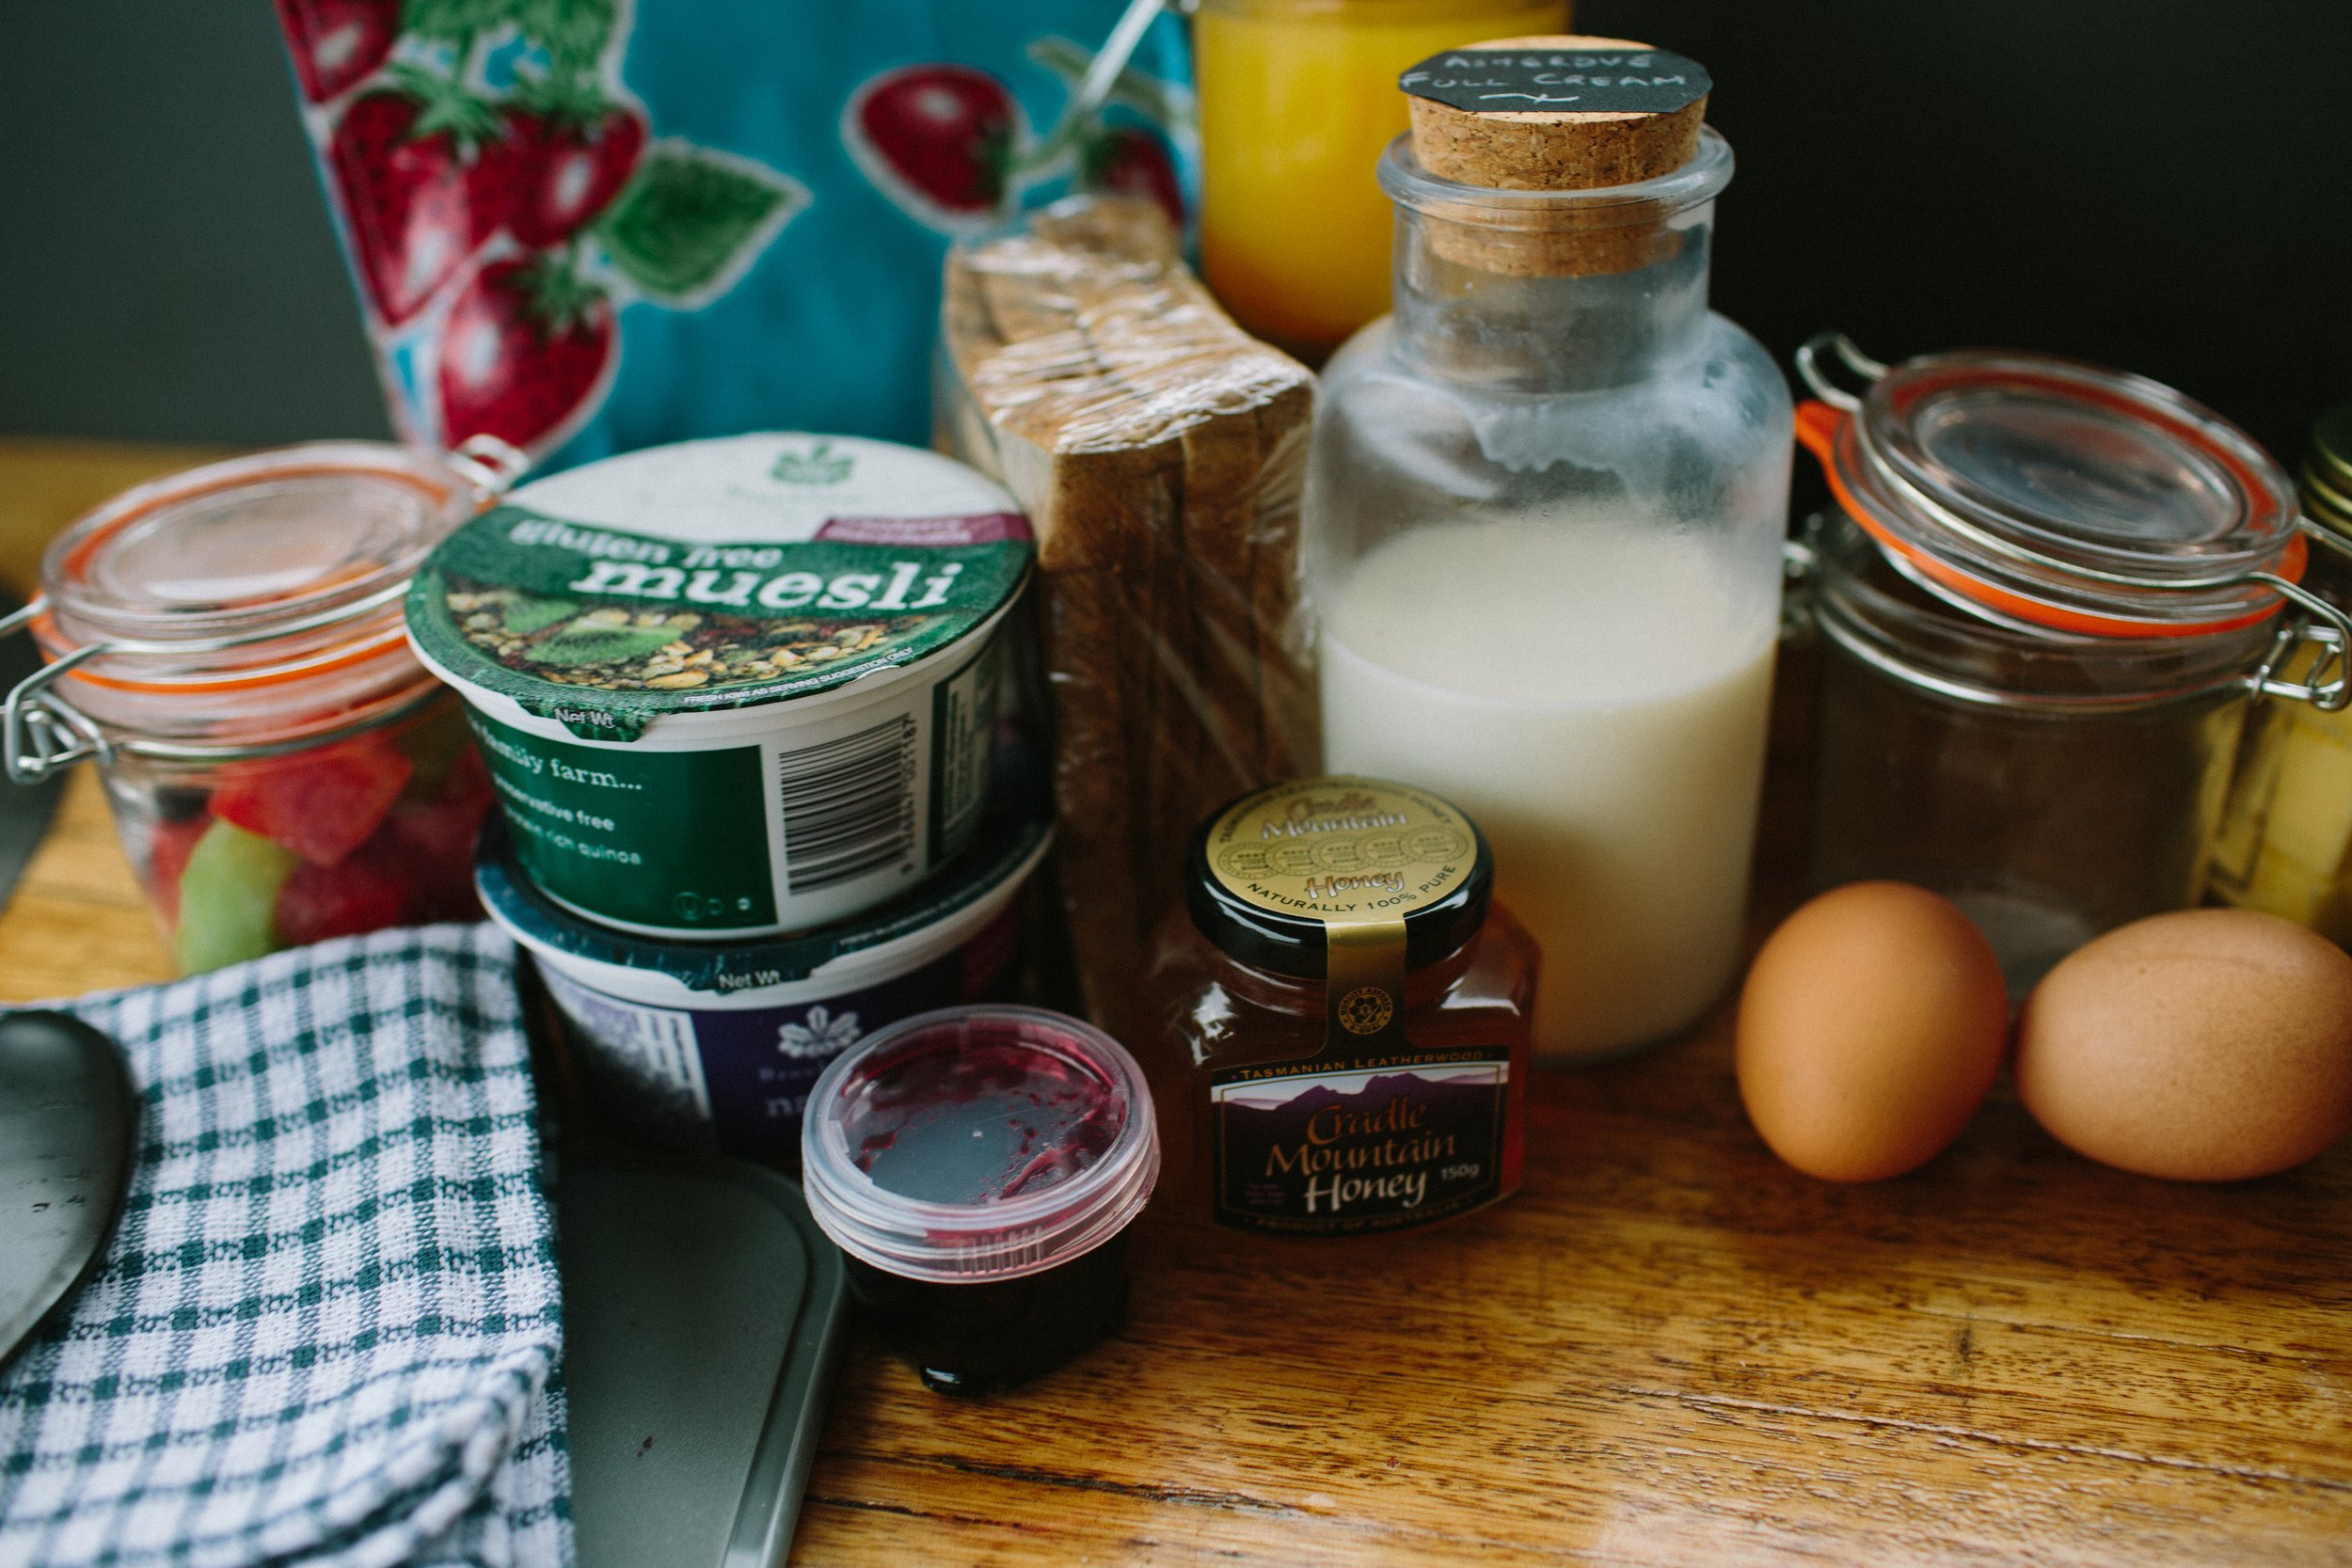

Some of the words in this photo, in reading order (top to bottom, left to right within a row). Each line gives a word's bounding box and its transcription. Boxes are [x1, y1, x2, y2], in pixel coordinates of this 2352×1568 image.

[1400, 71, 1511, 88] FULL
[1532, 72, 1687, 87] CREAM
[682, 545, 784, 568] free
[568, 561, 963, 610] muesli
[684, 692, 723, 705] FRESH
[769, 676, 819, 695] SERVING
[818, 655, 888, 684] SUGGESTION
[885, 645, 914, 664] ONLY
[554, 707, 586, 724] Net
[587, 710, 614, 727] Wt
[550, 757, 644, 790] farm...
[576, 809, 616, 832] free
[1248, 882, 1358, 912] NATURALLY
[1367, 891, 1417, 910] 100%
[1419, 864, 1457, 895] PURE
[1304, 870, 1405, 899] Honey
[718, 973, 750, 990] Net
[755, 969, 781, 986] Wt
[1241, 1060, 1345, 1081] TASMANIAN
[1355, 1051, 1484, 1069] LEATHERWOOD
[1308, 1096, 1426, 1145] Cradle
[1265, 1133, 1454, 1177] Mountain
[1440, 1163, 1481, 1182] 150g
[1303, 1171, 1427, 1213] Honey
